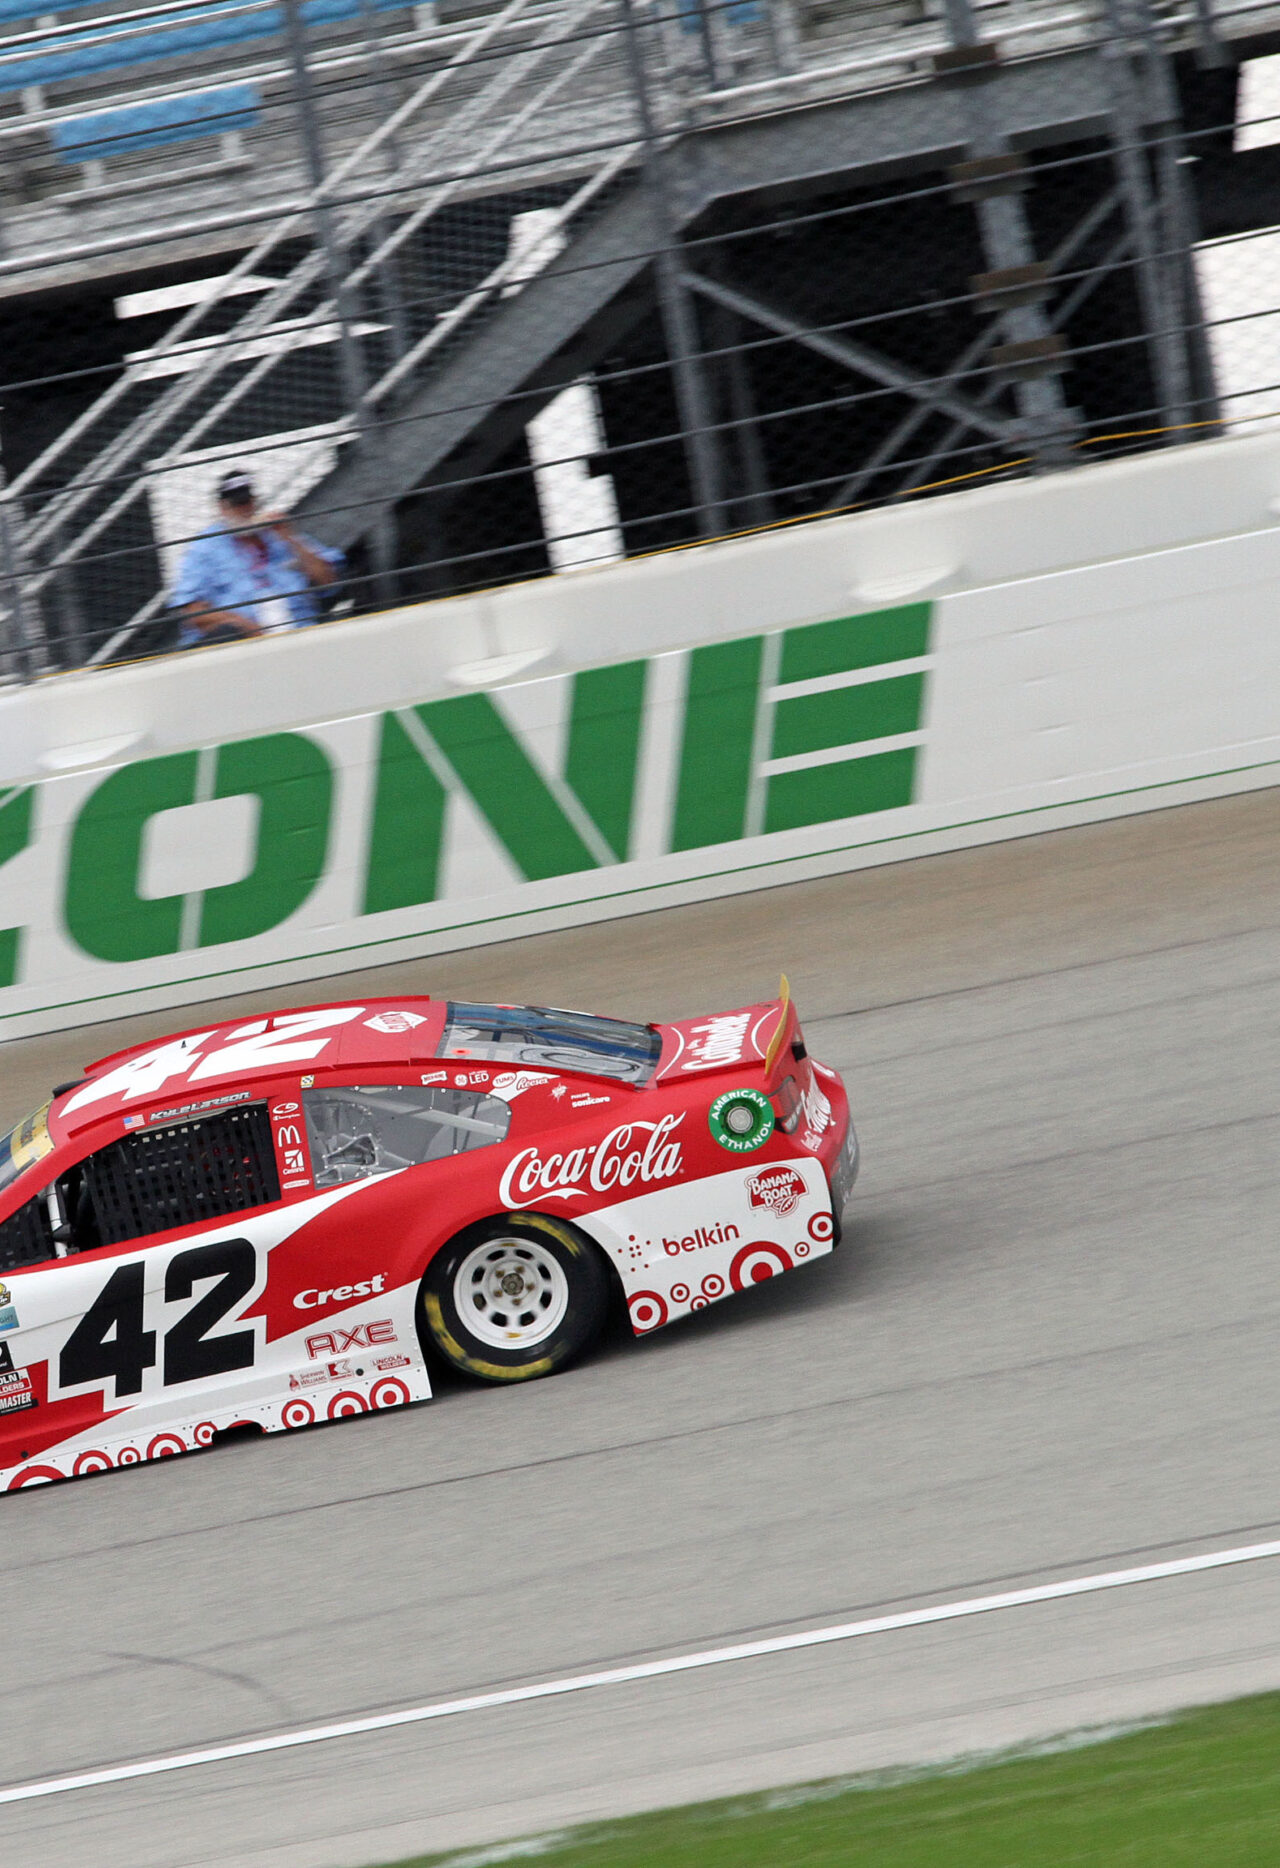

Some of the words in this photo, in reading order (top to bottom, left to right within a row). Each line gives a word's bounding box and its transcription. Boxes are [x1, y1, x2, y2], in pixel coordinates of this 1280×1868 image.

[58, 1007, 366, 1118] 42
[469, 1073, 489, 1084] LED
[572, 1096, 610, 1108] sonicare
[711, 1090, 767, 1121] AMERICAN
[718, 1121, 772, 1150] ETHANOL
[499, 1111, 687, 1210] Coca-Cola
[748, 1171, 799, 1195] BANANA
[760, 1184, 793, 1208] BOAT
[662, 1222, 740, 1256] belkin
[292, 1274, 385, 1310] Crest
[59, 1237, 257, 1398] 42
[304, 1318, 398, 1361] AXE
